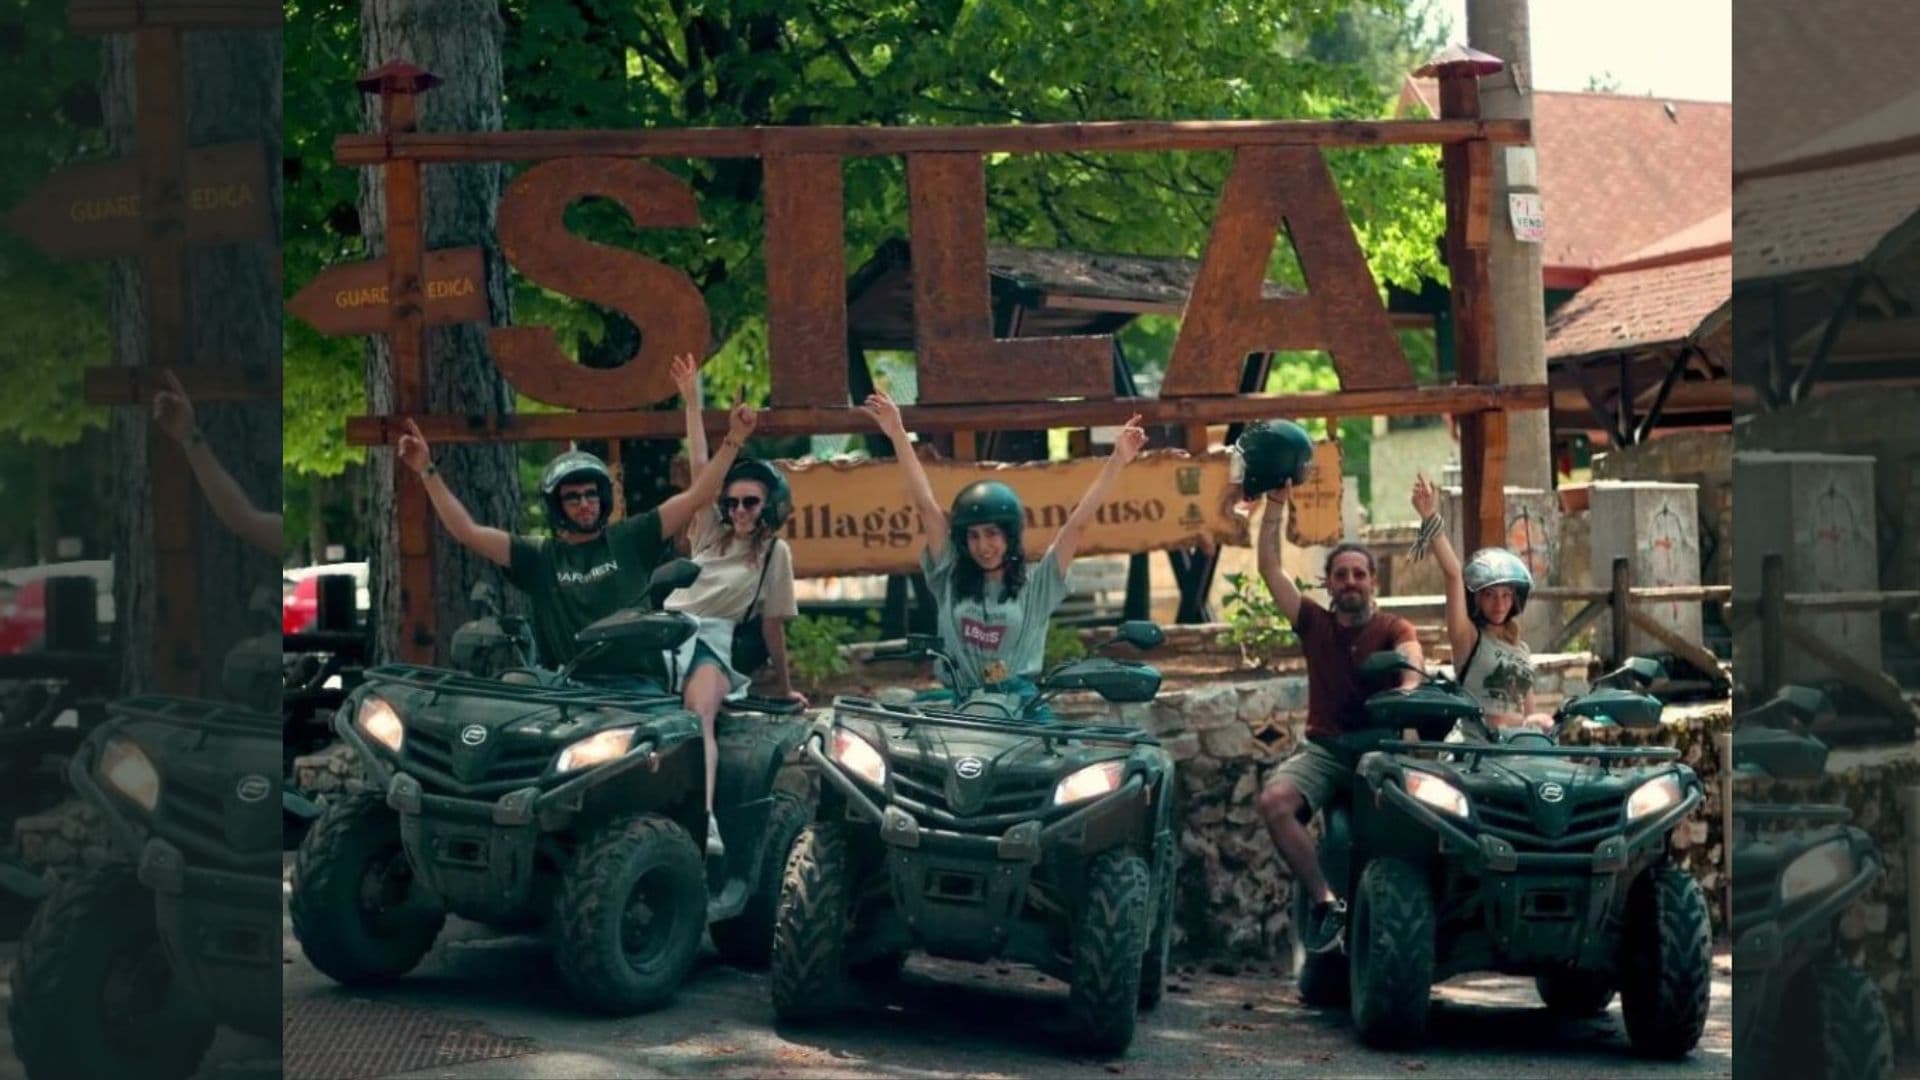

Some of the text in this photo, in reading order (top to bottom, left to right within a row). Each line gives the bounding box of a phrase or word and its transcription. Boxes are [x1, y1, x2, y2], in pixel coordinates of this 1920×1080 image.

[70, 183, 254, 224] GUARD EDICA
[335, 276, 475, 309] GUARD EDICA
[489, 145, 1417, 411] SILA
